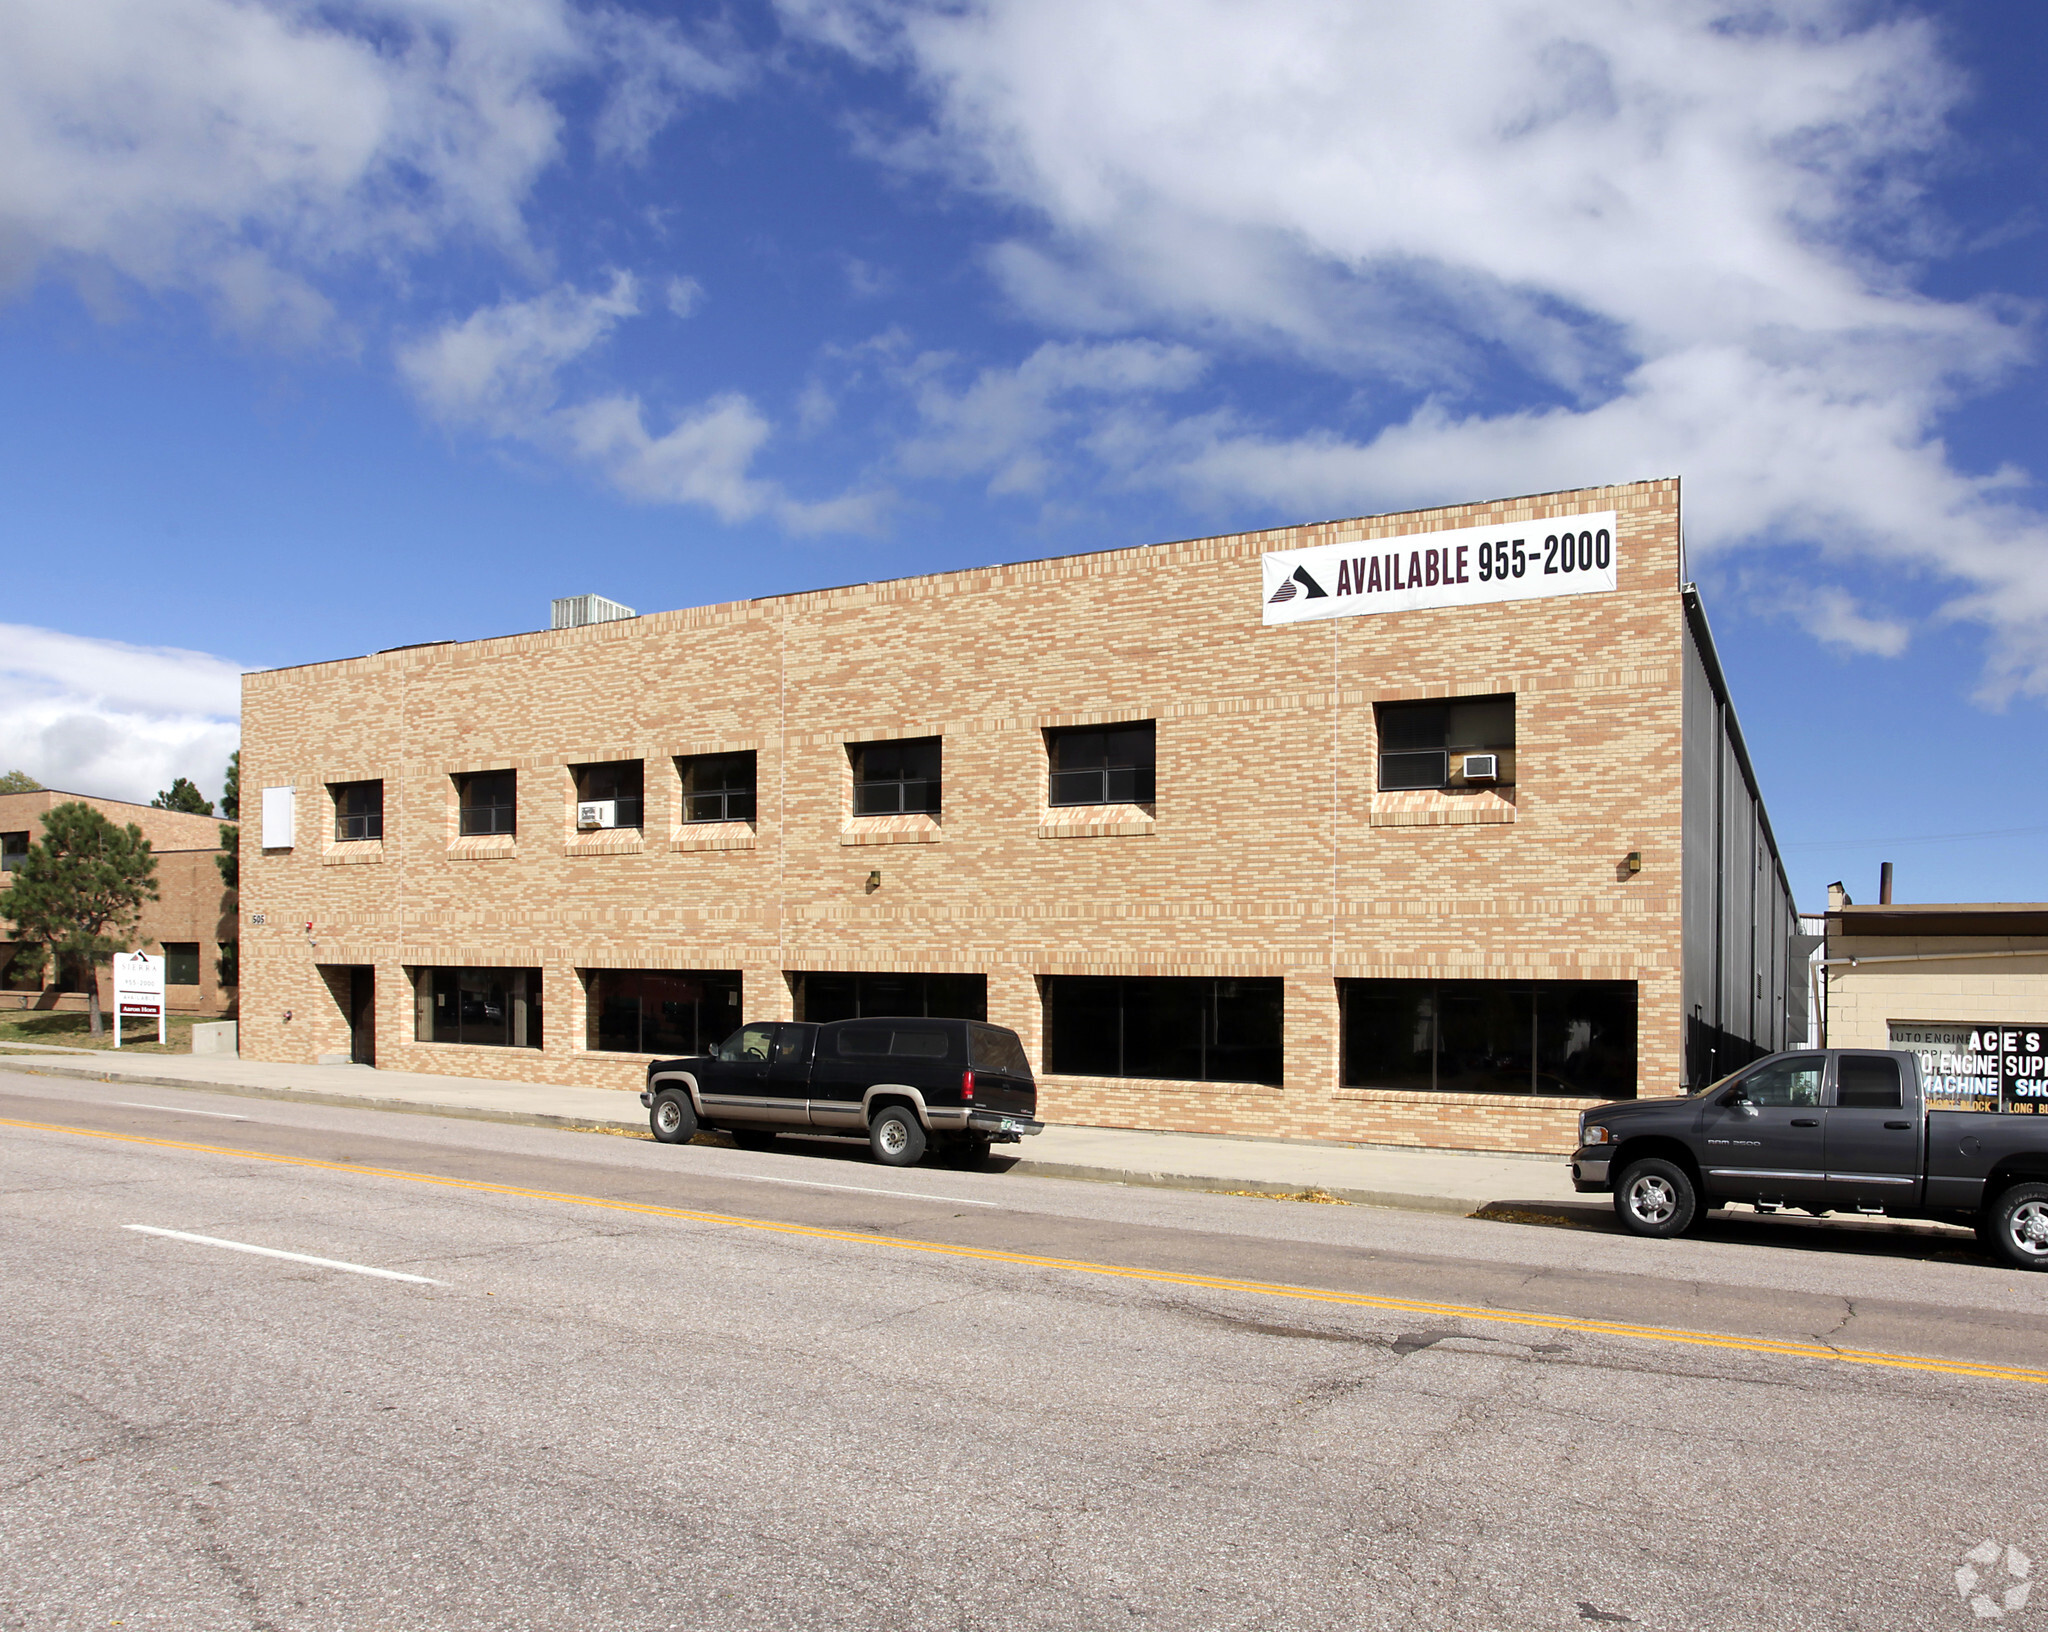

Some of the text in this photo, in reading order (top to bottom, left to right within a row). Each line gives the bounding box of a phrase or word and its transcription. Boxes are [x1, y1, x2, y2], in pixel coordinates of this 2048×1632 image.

[1336, 528, 1611, 597] AVAILABLE 955-2000
[252, 915, 265, 924] 505
[121, 963, 157, 972] SIERRA
[1968, 1030, 2041, 1052] ACE'S
[1940, 1053, 1999, 1076] ENGINE
[1959, 1100, 1992, 1112] BLOCK
[2008, 1102, 2034, 1114] LONG
